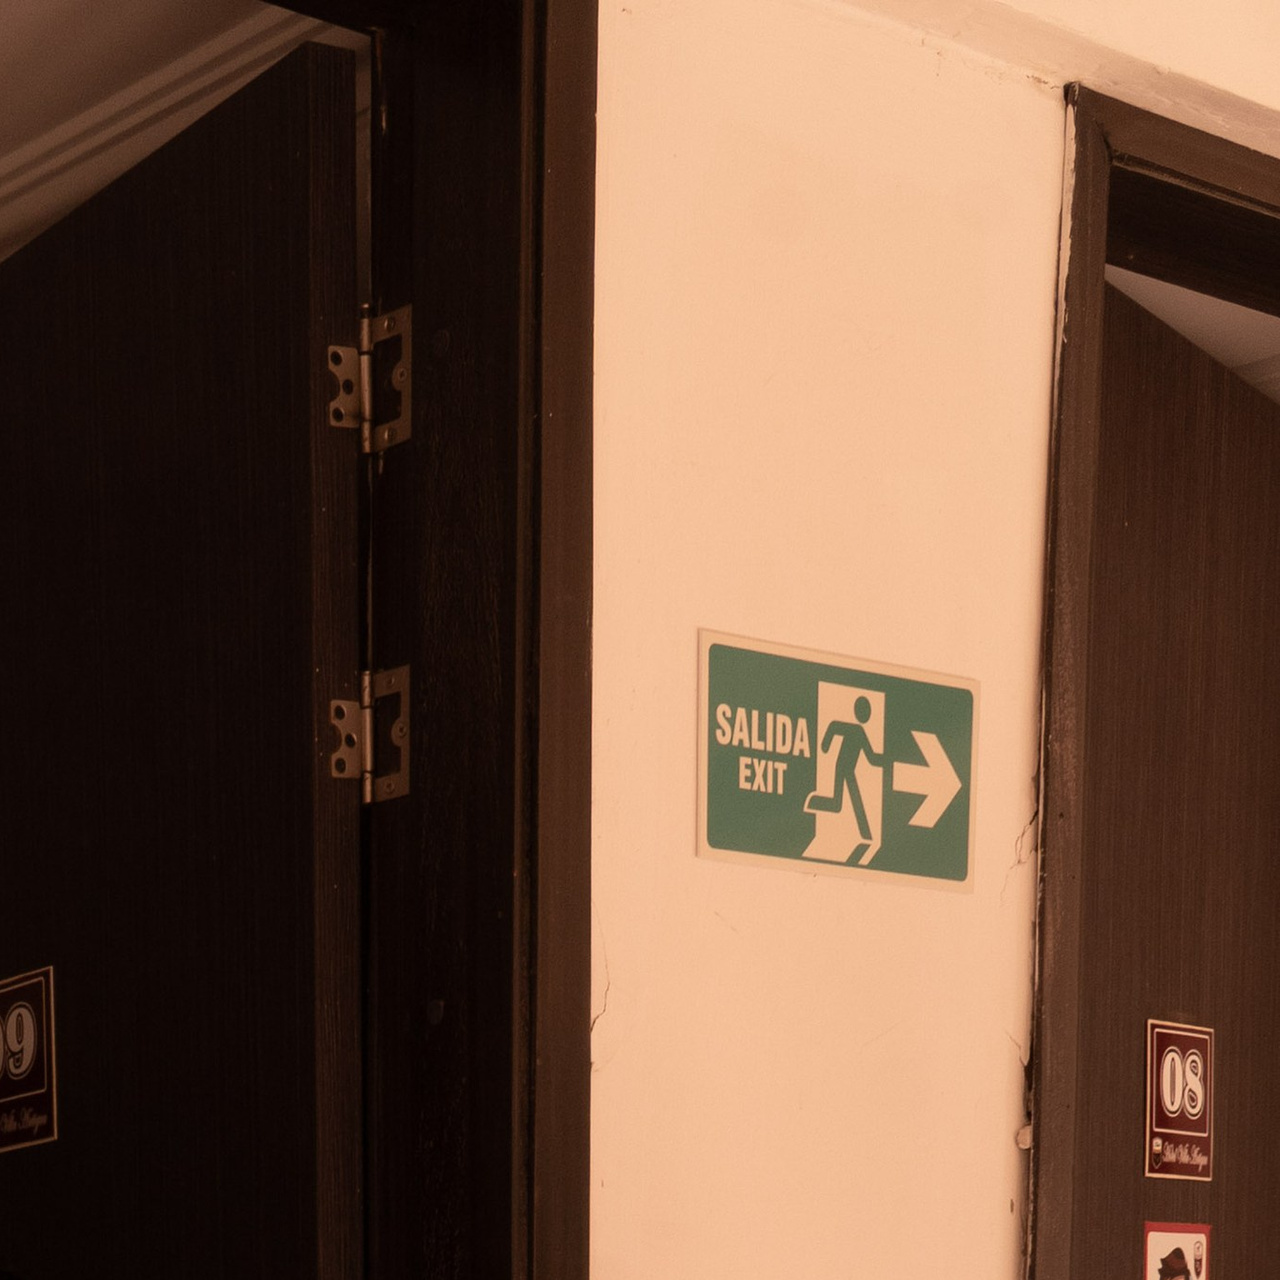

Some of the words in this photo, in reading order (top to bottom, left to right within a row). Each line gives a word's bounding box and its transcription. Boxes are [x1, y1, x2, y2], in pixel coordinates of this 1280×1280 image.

[715, 703, 811, 758] SALIDA
[738, 756, 788, 795] EXIT
[1160, 1046, 1205, 1120] 08
